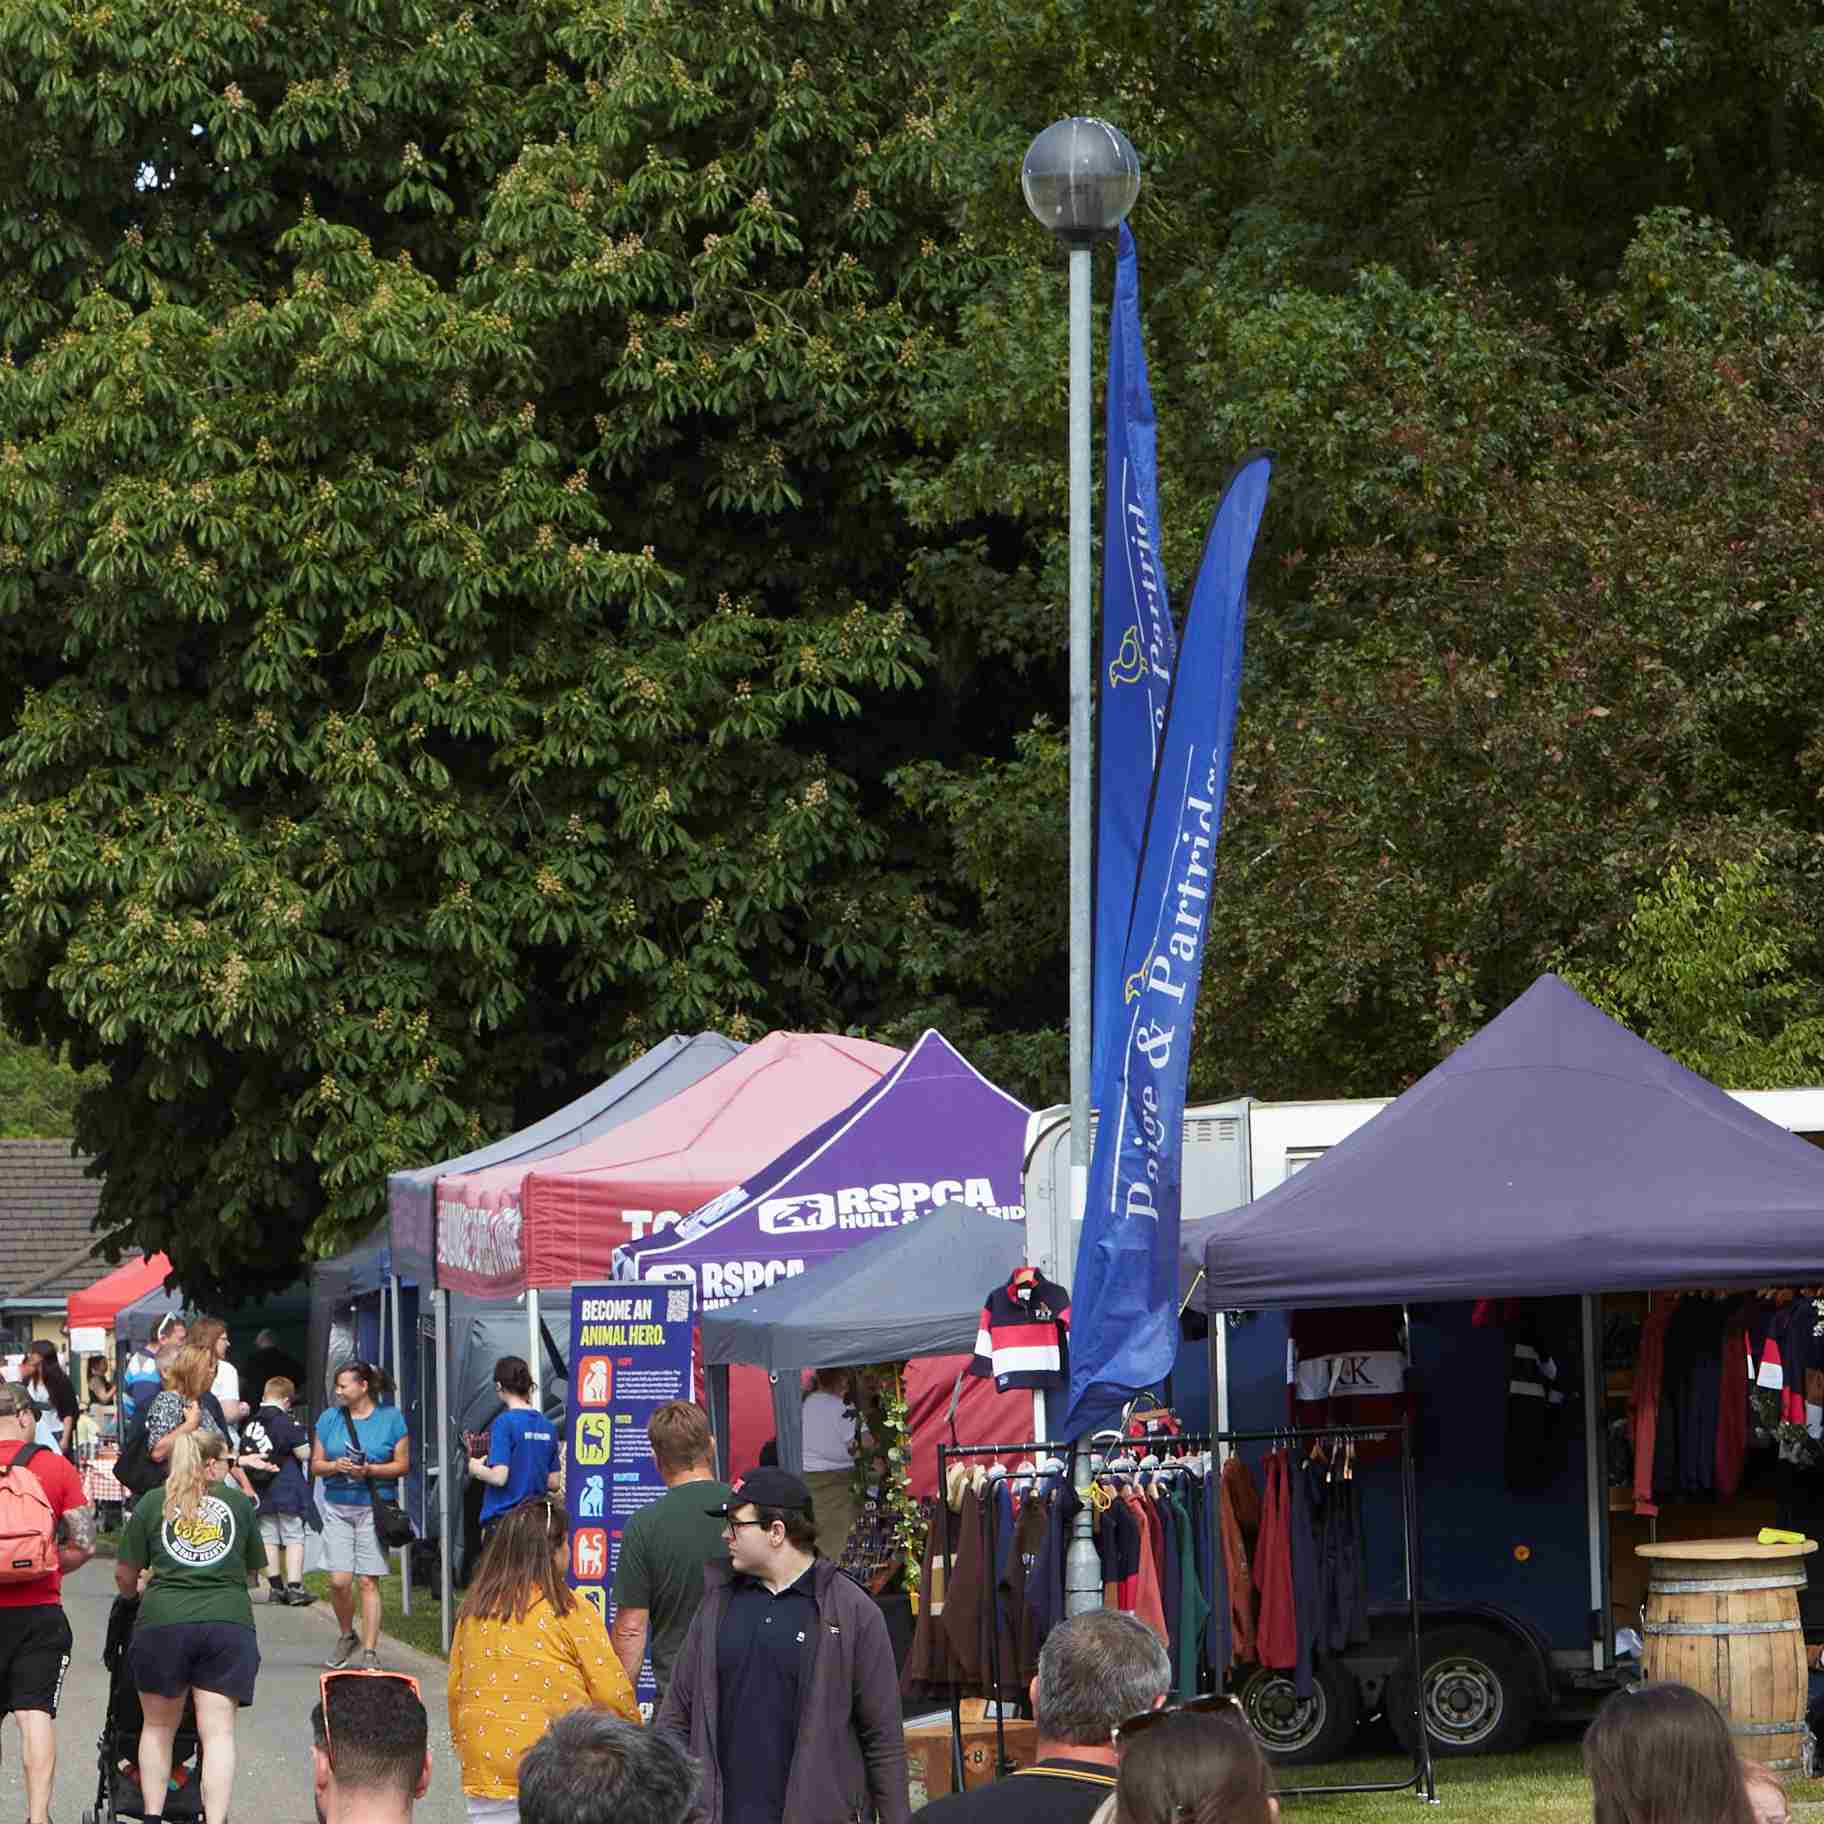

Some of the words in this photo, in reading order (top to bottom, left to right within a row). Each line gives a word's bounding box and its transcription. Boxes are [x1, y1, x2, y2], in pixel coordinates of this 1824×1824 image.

[1147, 746, 1218, 1005] Partrid
[1136, 1017, 1176, 1070] &
[837, 1178, 996, 1215] RSPCA
[839, 1211, 899, 1229] HULL
[582, 1299, 632, 1321] BECOME
[632, 1299, 652, 1321] AN
[580, 1325, 627, 1346] ANIMAL
[628, 1324, 666, 1345] HERO.
